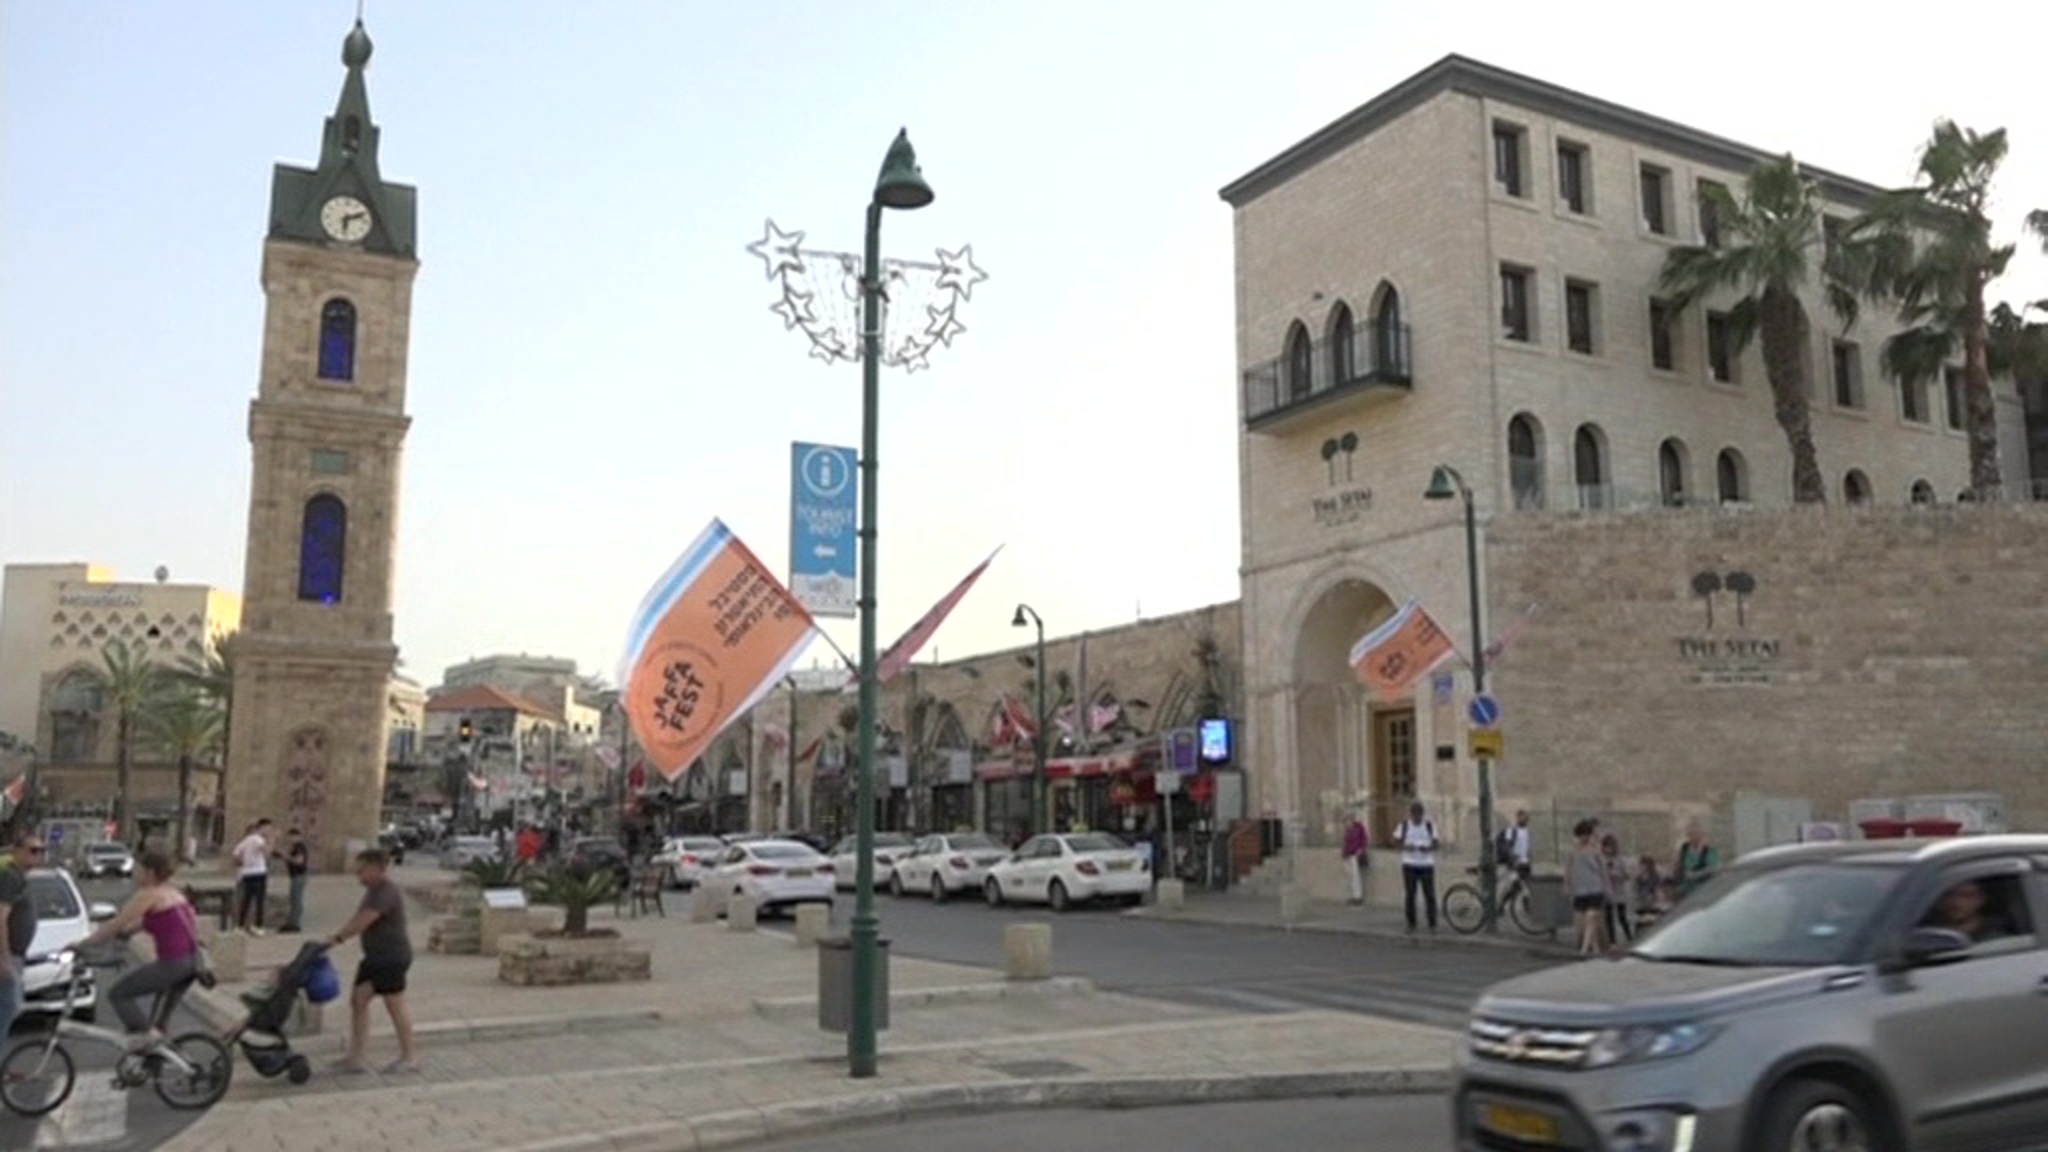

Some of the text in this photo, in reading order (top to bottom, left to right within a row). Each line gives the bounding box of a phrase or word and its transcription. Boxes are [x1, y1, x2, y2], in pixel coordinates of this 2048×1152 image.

[708, 562, 758, 610] פסטיבל
[1674, 638, 1780, 658] THE SETAI
[654, 662, 692, 730] JAFFA
[669, 674, 704, 732] FEST
